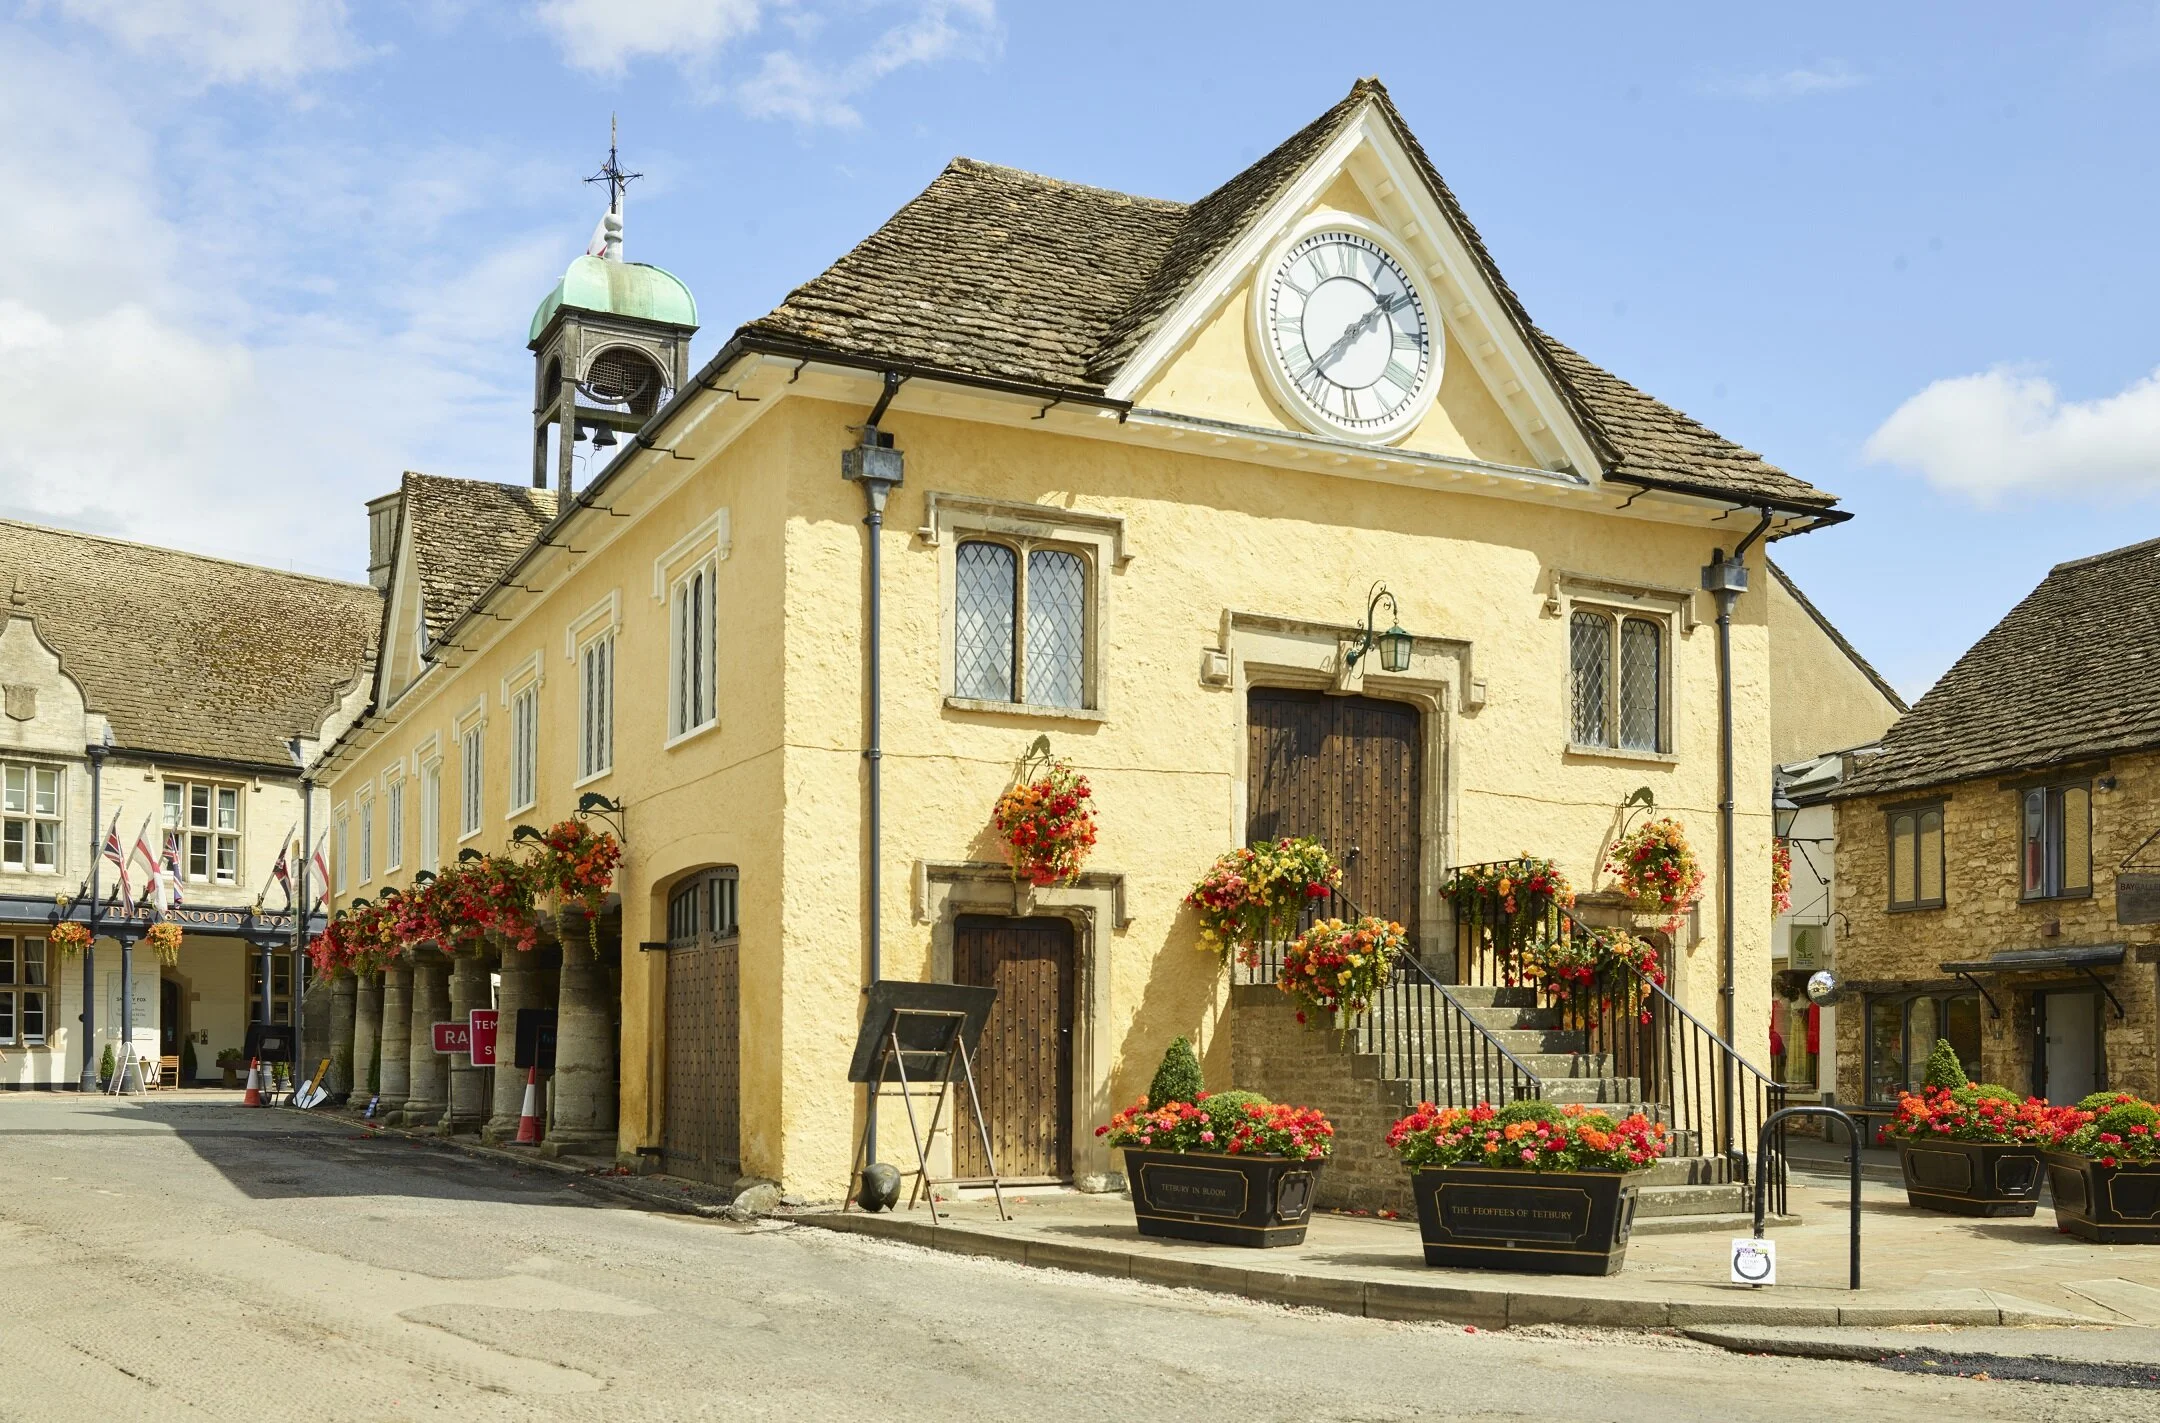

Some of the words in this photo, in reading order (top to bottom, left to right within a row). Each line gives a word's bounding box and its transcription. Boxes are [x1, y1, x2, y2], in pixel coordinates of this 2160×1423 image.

[107, 905, 150, 919] THE
[1161, 1183, 1190, 1193] TETBURY
[1202, 1187, 1226, 1197] BLOOM
[1452, 1206, 1469, 1215] THE
[1473, 1207, 1515, 1217] FEOFFEES
[1517, 1209, 1528, 1217] OF
[1533, 1210, 1573, 1220] TETBURY
